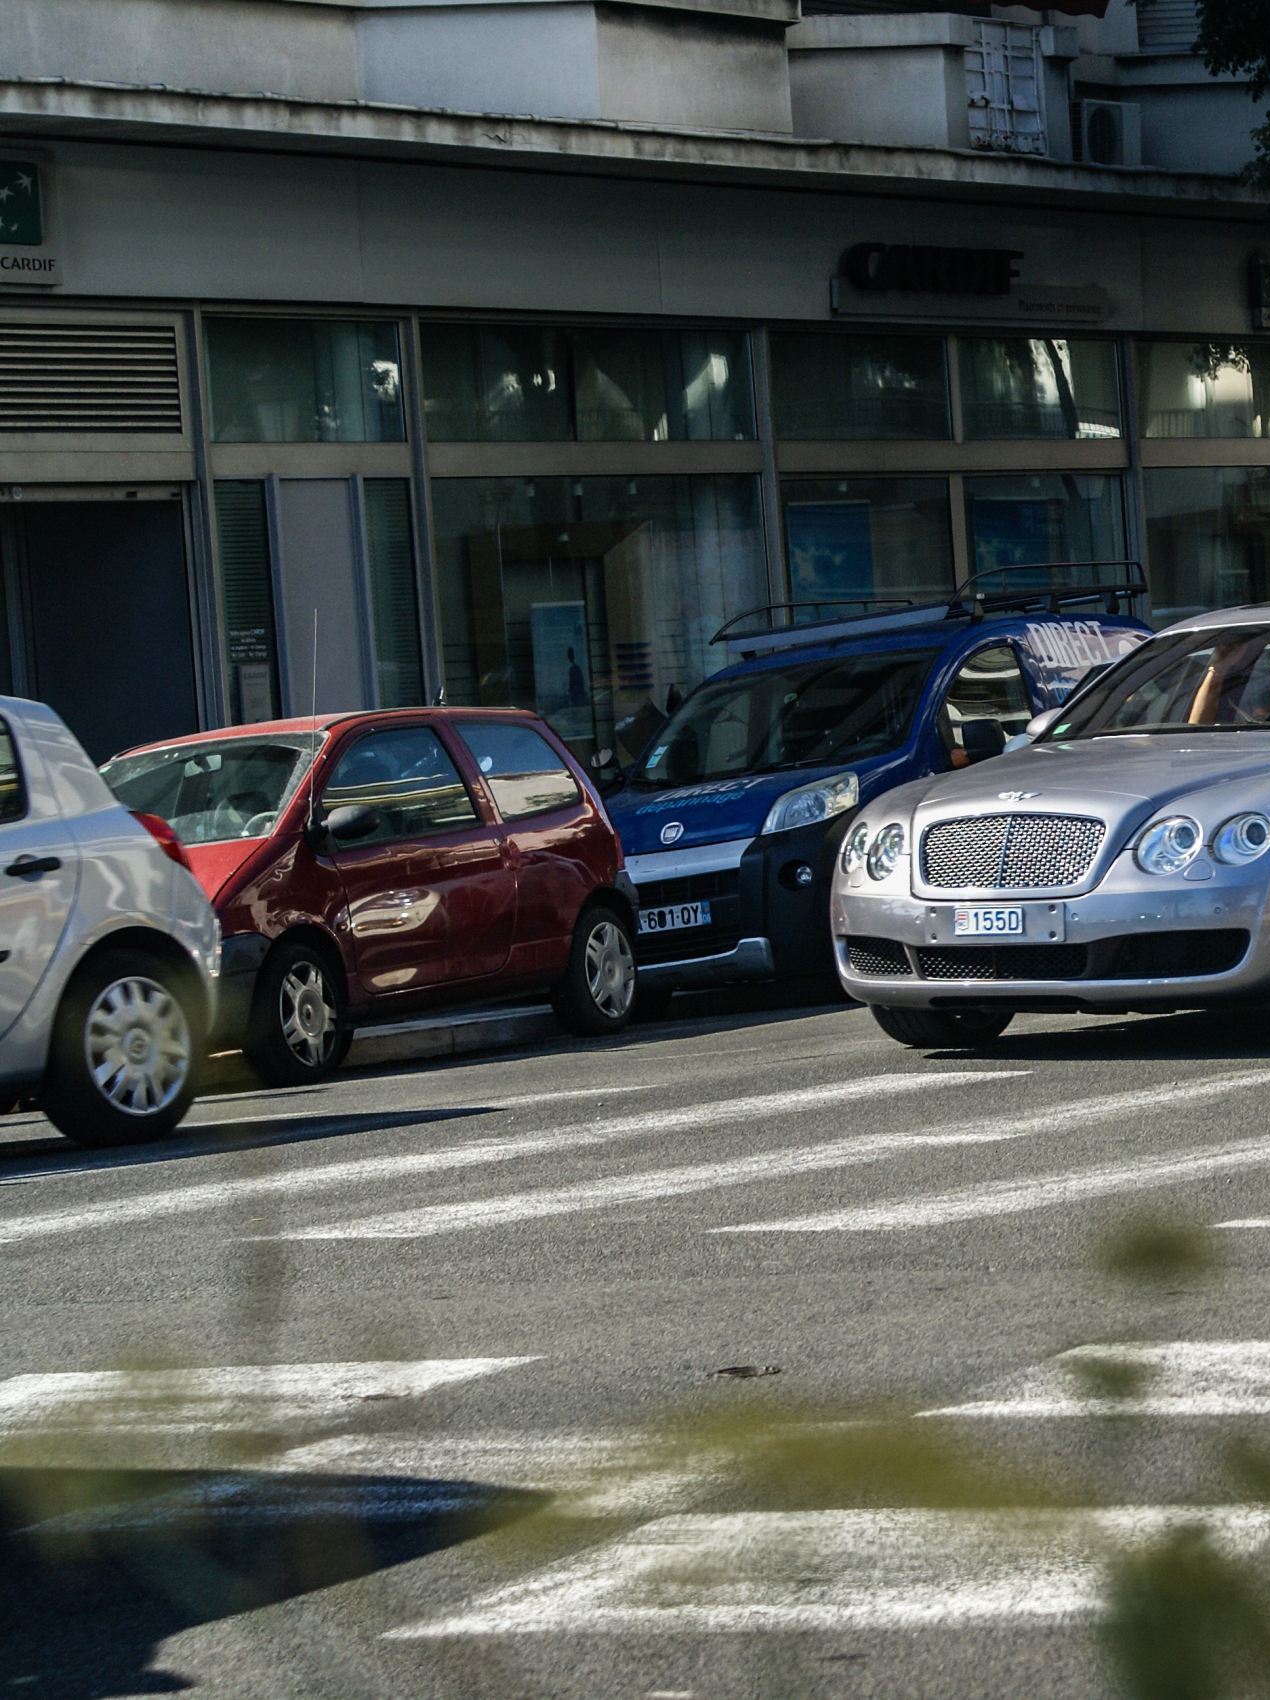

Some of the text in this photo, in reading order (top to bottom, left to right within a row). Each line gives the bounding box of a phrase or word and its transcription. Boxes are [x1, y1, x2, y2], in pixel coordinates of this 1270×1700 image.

[1, 256, 57, 272] CARDIF
[1025, 620, 1112, 668] DIRECT
[653, 776, 775, 803] DIRECT
[973, 910, 1019, 931] 155D
